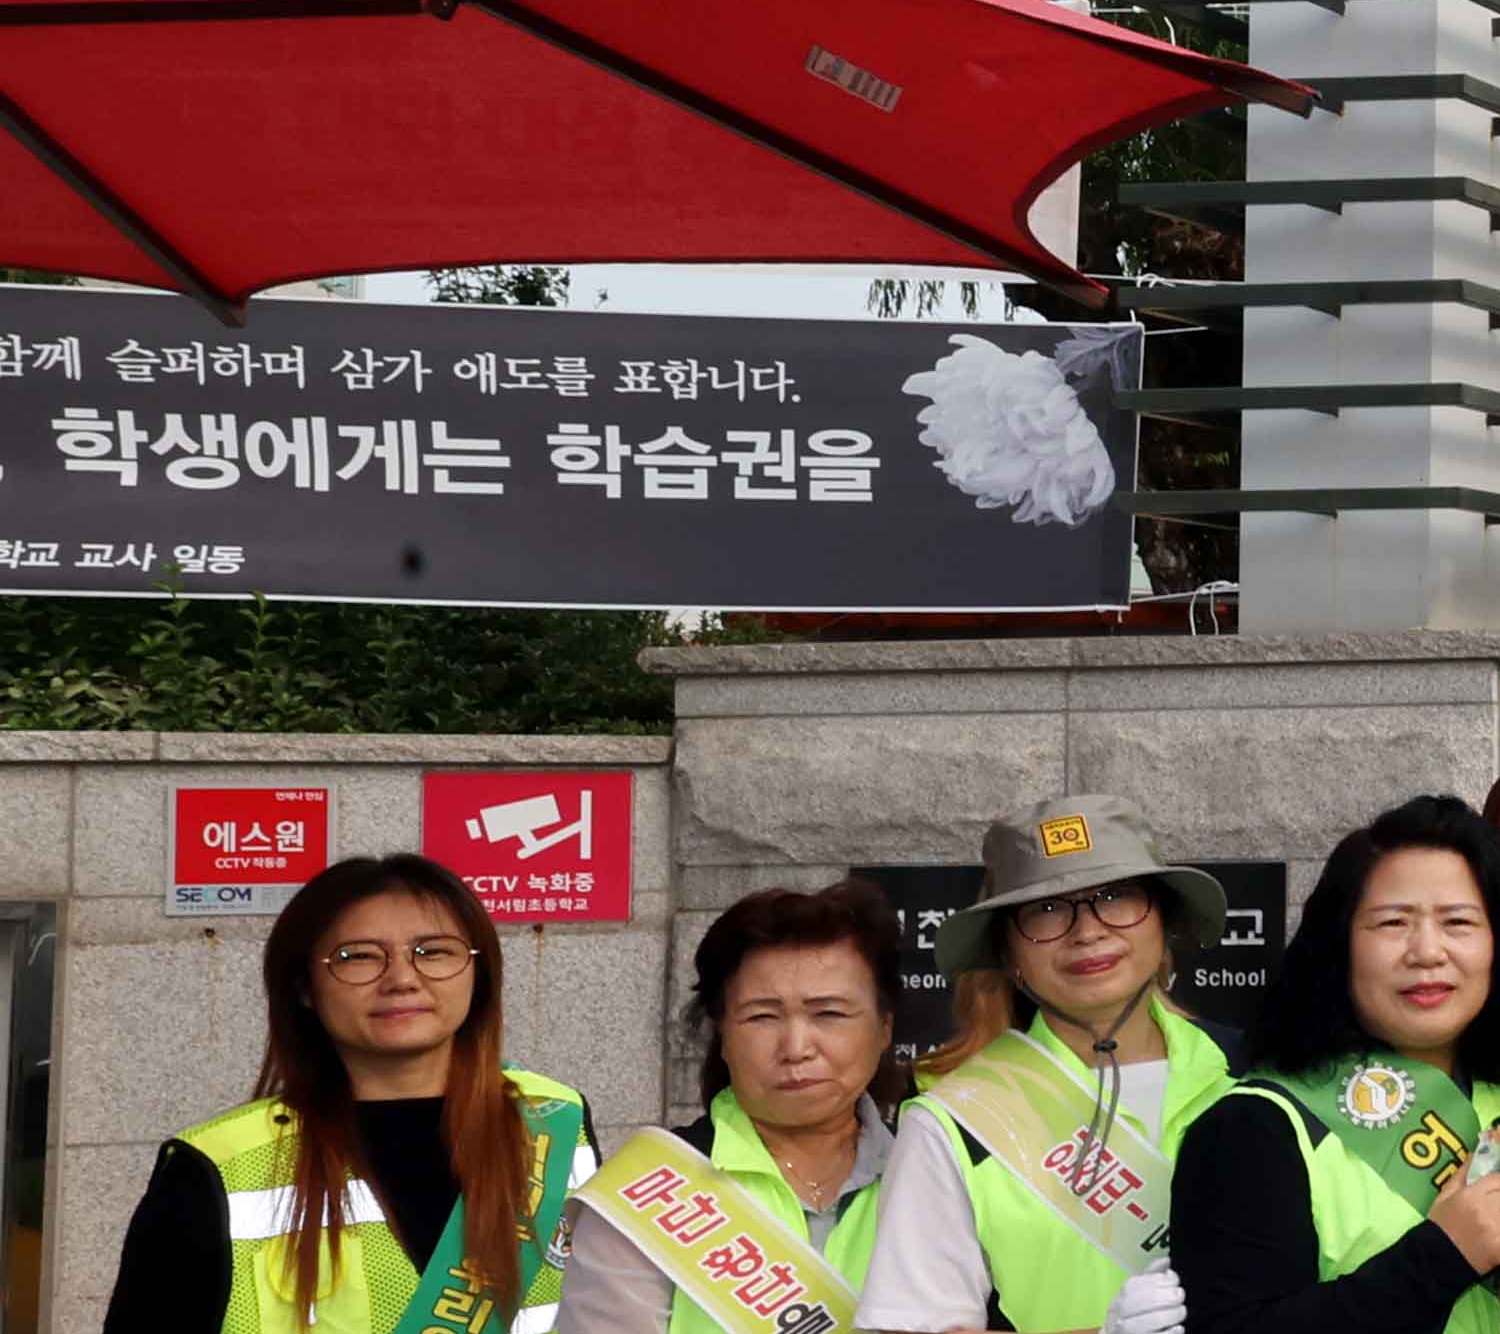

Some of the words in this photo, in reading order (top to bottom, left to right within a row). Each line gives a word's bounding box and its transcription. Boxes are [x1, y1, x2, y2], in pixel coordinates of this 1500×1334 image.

[106, 338, 306, 389] 슬퍼하며
[330, 347, 431, 393] 삼가
[453, 352, 595, 397] 애도를
[614, 358, 801, 403] 표합니다.
[51, 407, 511, 494] 학생에게는
[546, 423, 881, 501] 학습권을
[74, 542, 156, 571] 교사
[173, 544, 245, 574] 일동
[203, 821, 304, 853] 에스원
[215, 857, 250, 869] CCTV
[176, 887, 252, 903] SECOM
[527, 873, 595, 893] 녹화중
[1195, 969, 1266, 987] School
[619, 1164, 728, 1247] 무단
